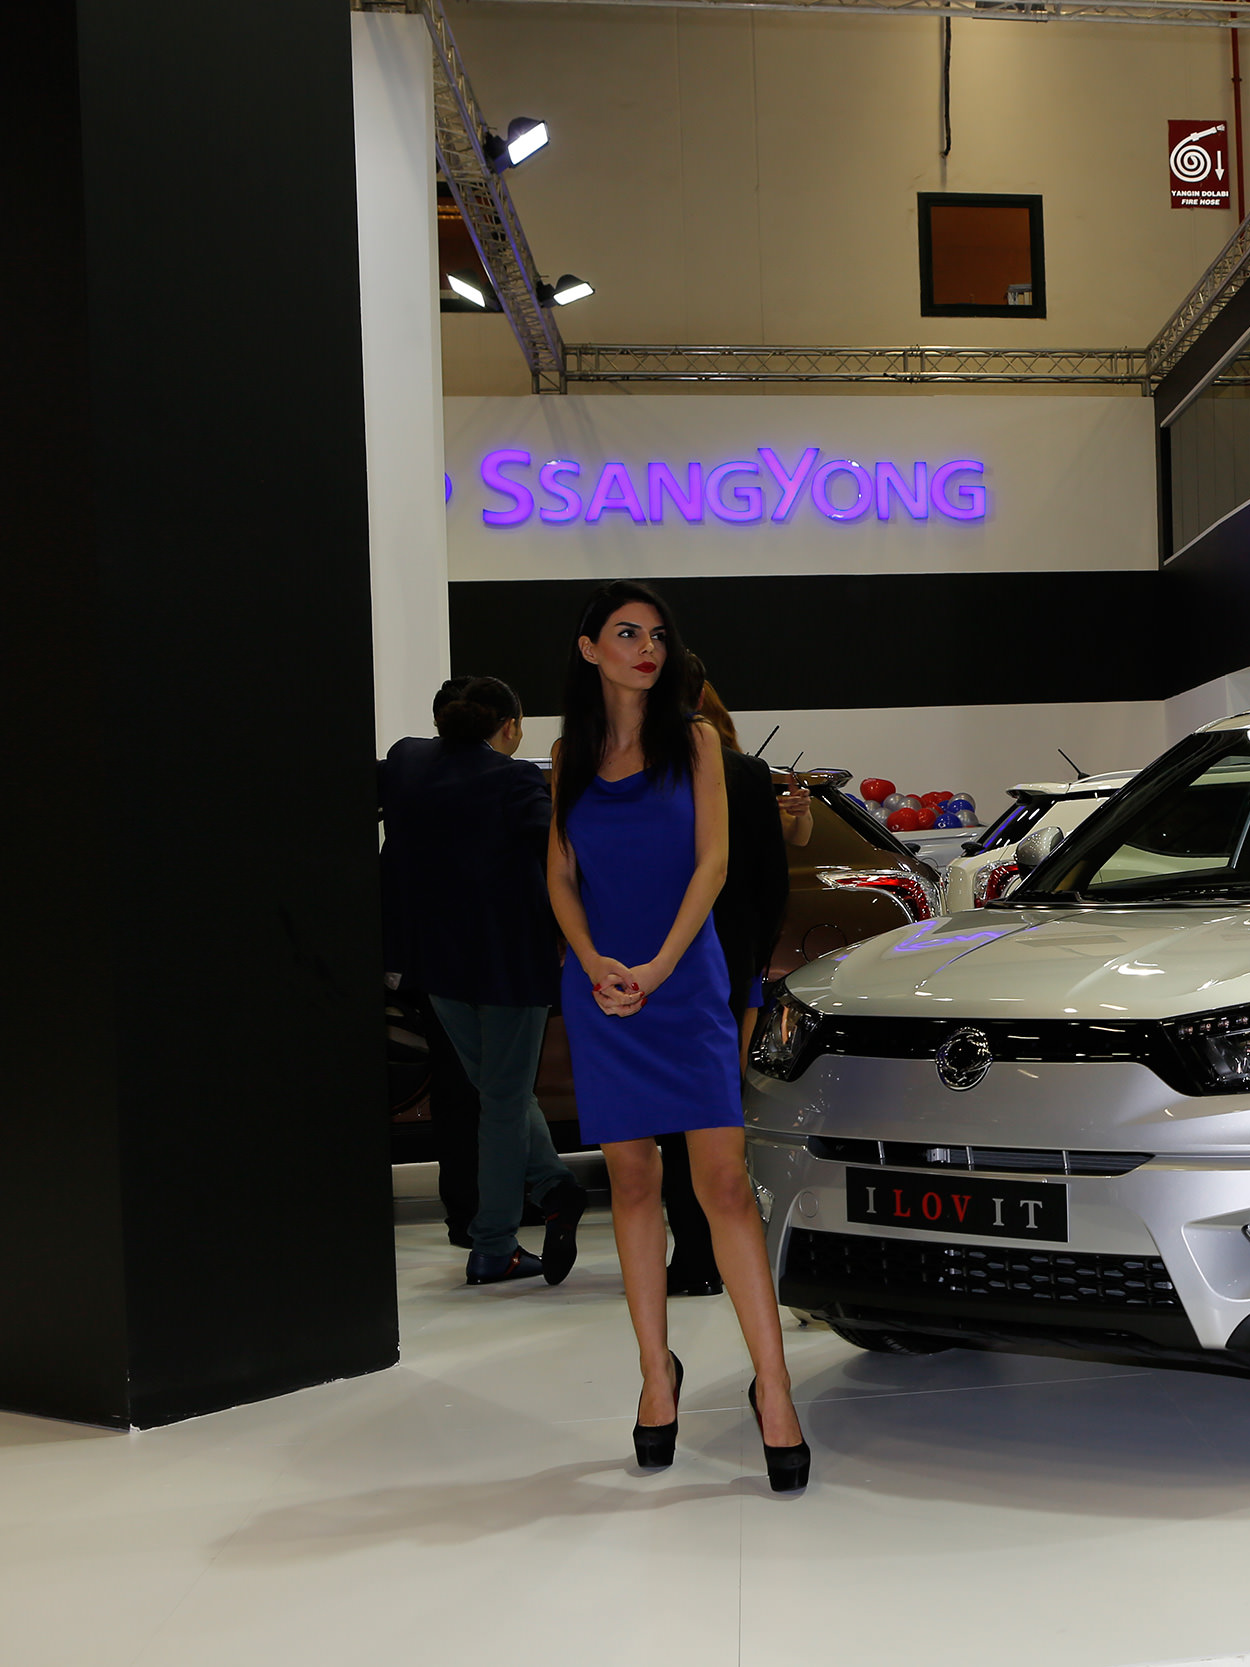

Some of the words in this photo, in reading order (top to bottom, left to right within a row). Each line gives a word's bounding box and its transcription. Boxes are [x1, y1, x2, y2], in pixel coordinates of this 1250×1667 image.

[1199, 198, 1221, 206] HOSE
[865, 1186, 877, 1214] I
[893, 1189, 972, 1223] LOV
[992, 1198, 1043, 1229] IT
